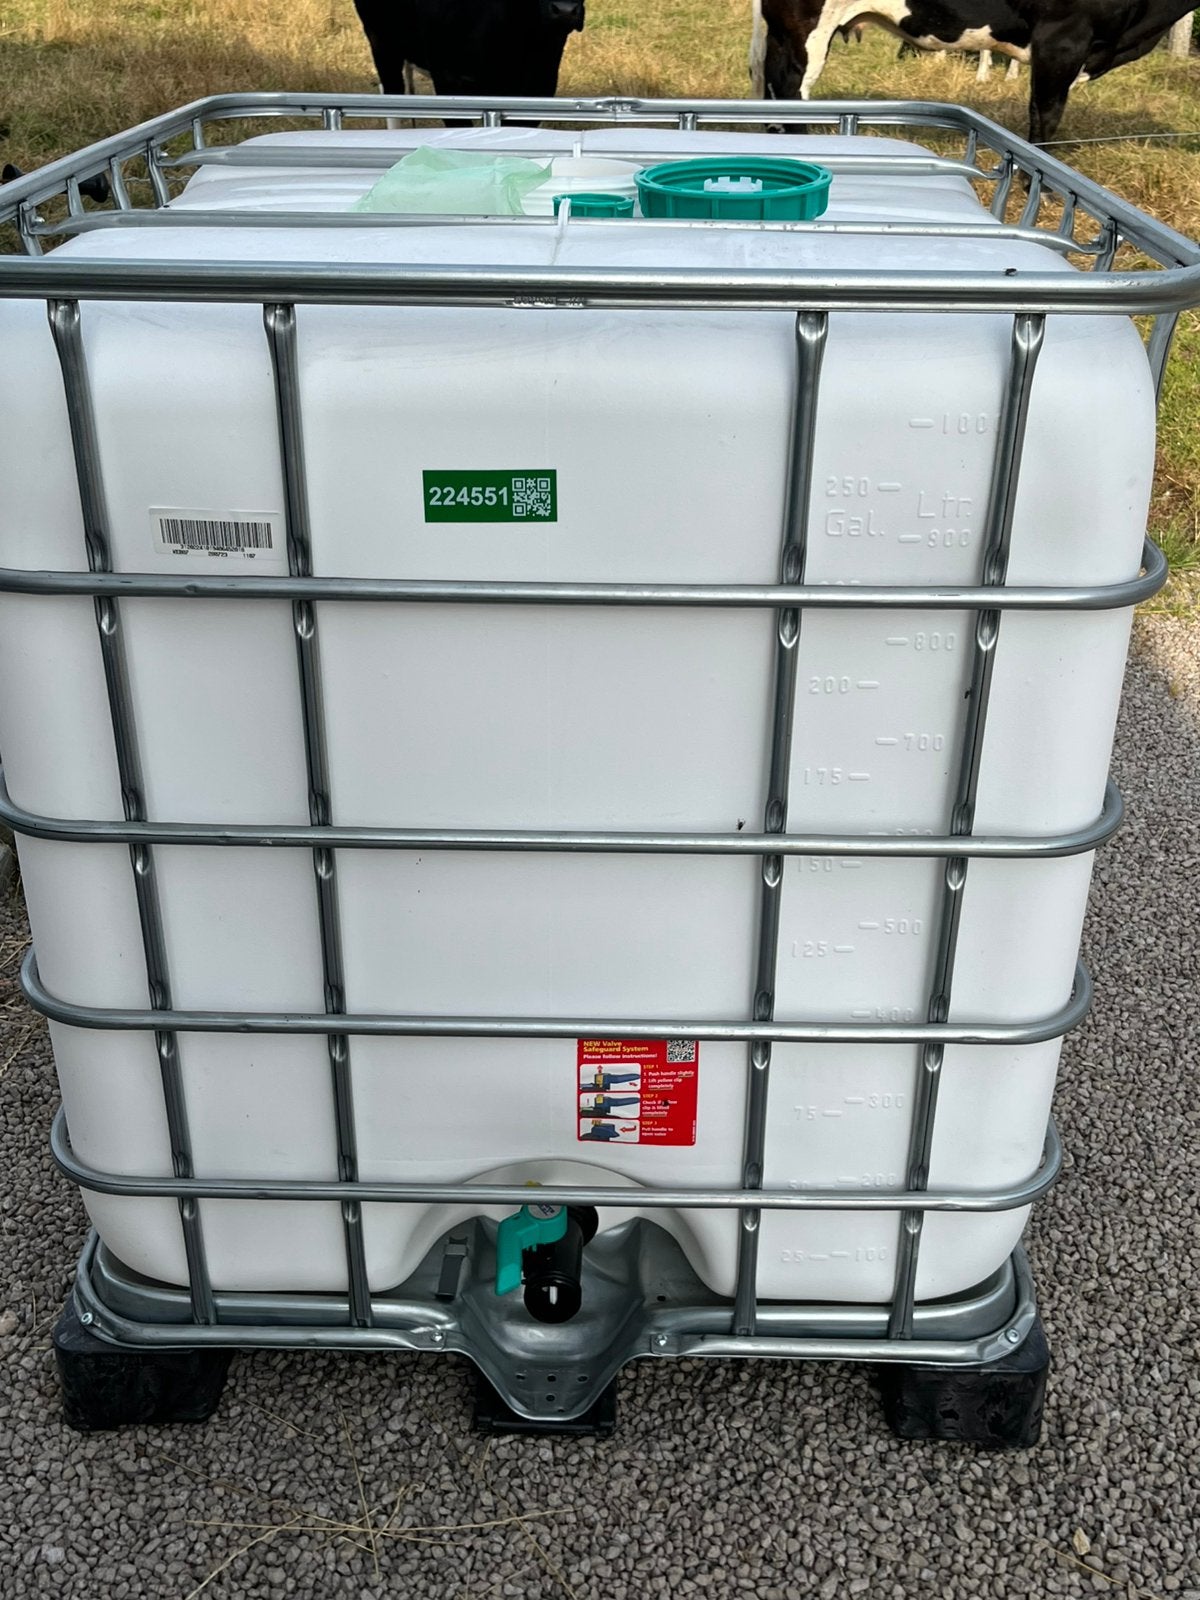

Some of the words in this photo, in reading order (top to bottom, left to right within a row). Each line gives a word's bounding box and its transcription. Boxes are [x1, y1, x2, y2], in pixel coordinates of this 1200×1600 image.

[825, 476, 871, 497] 250
[429, 486, 508, 506] 224551
[917, 491, 973, 518] Ltr.
[825, 509, 885, 536] Gal.
[914, 632, 957, 650] 800
[808, 676, 851, 694] 200
[904, 733, 945, 751] 700
[804, 768, 844, 785] 175
[884, 918, 924, 935] 500
[792, 941, 828, 958] 125
[794, 1106, 817, 1120] 75
